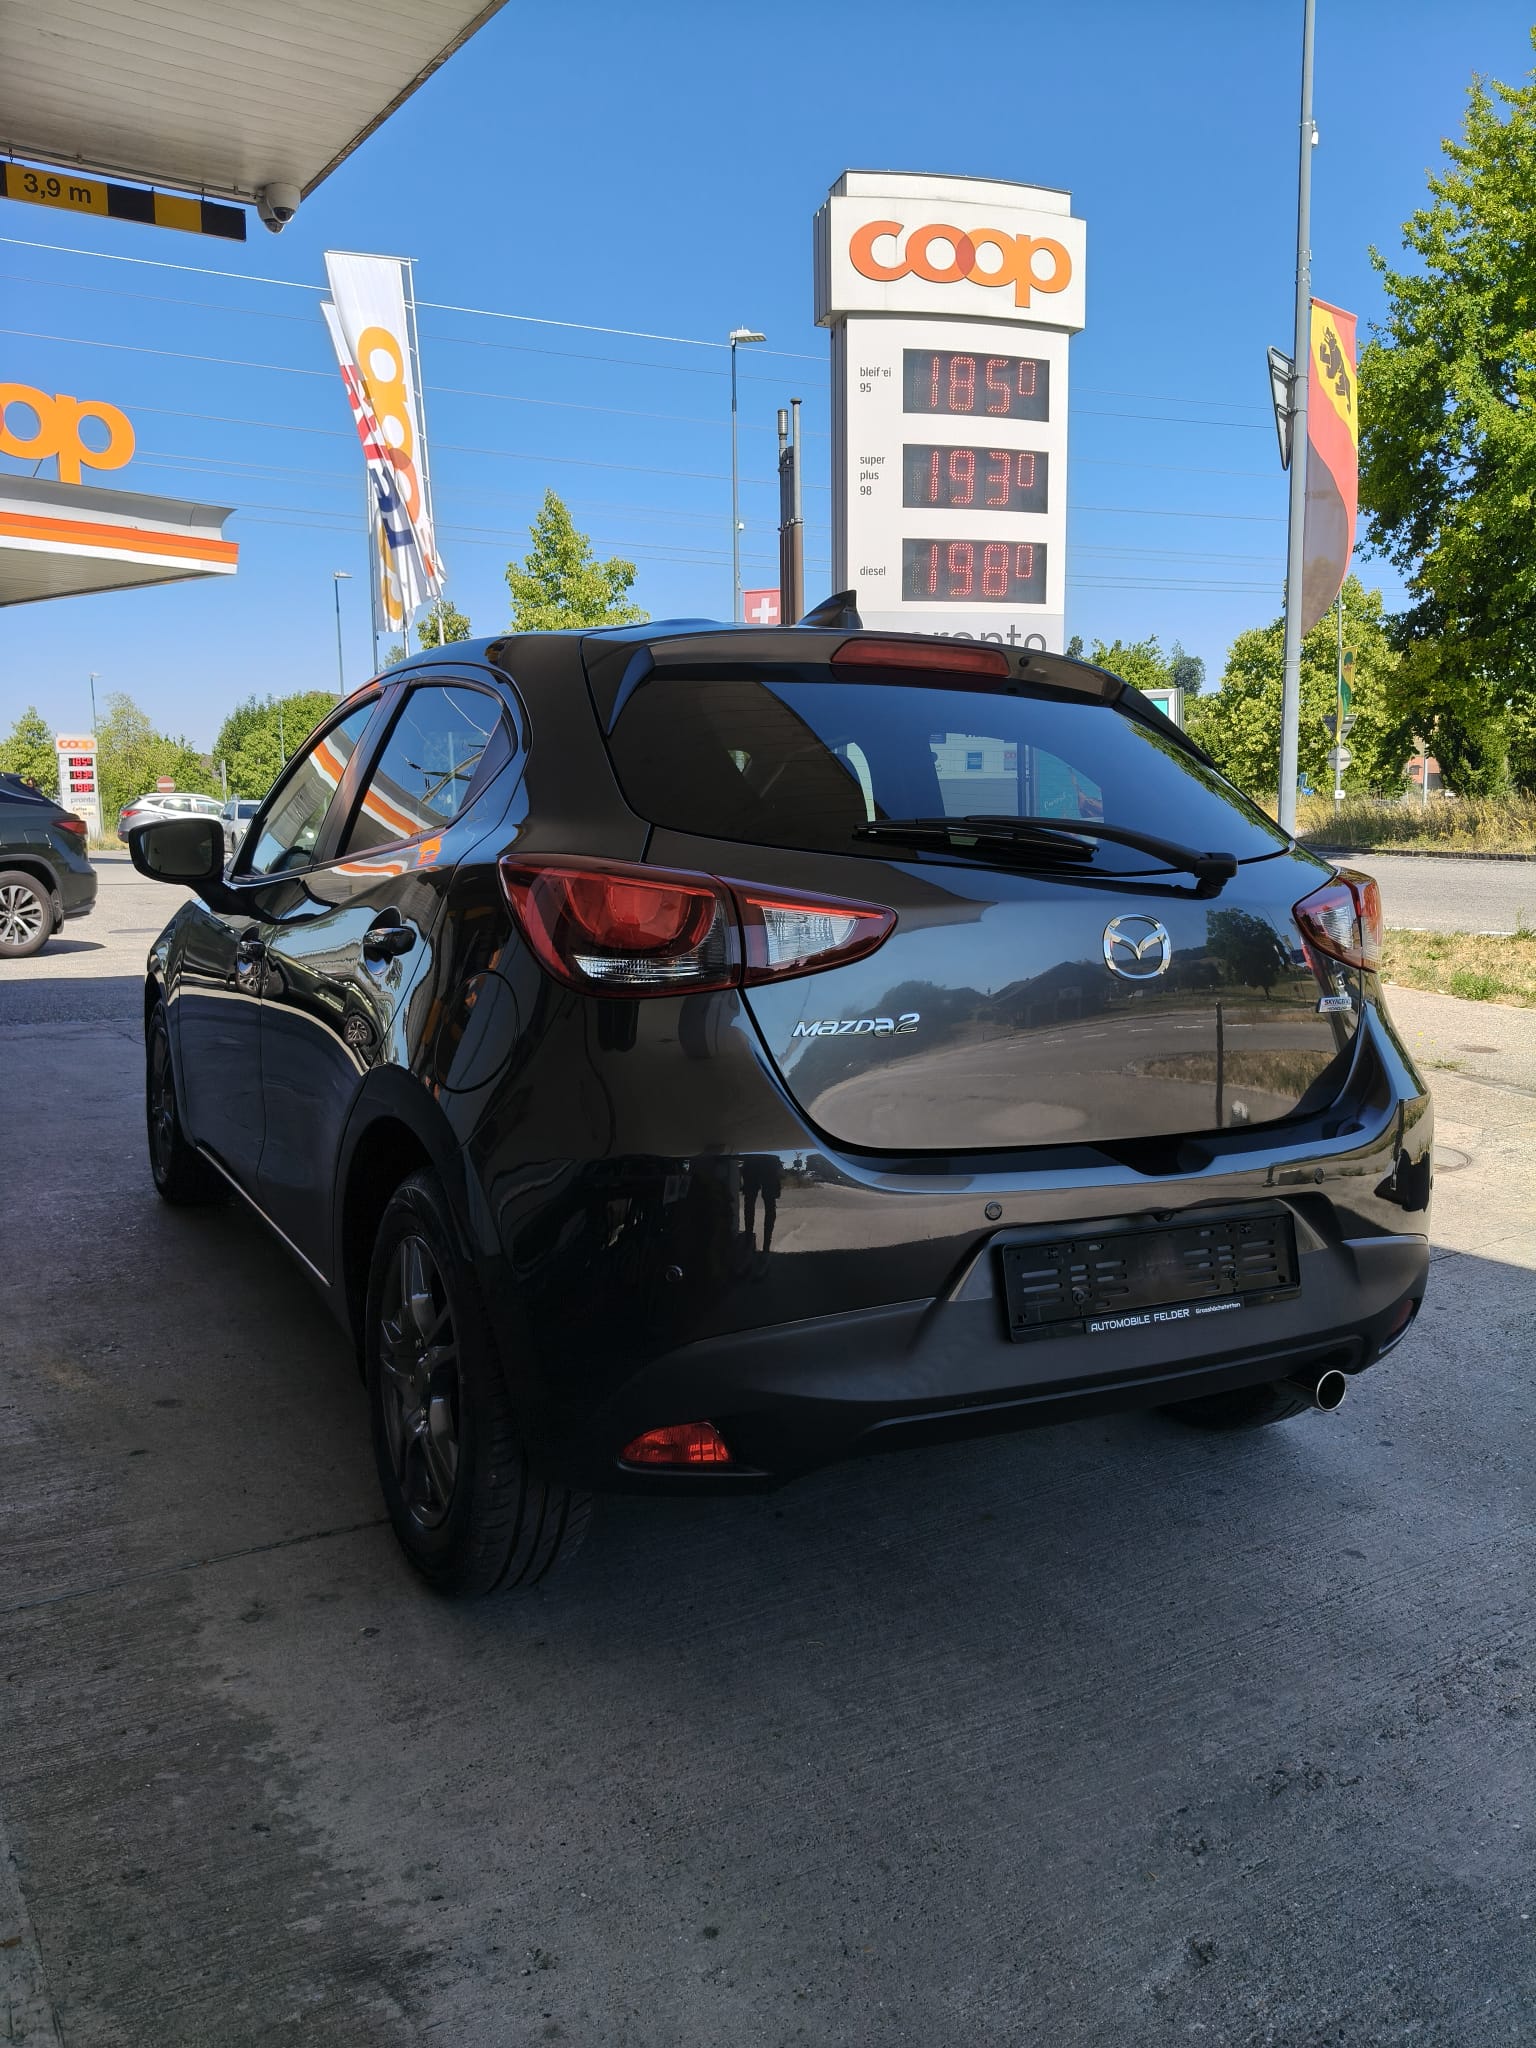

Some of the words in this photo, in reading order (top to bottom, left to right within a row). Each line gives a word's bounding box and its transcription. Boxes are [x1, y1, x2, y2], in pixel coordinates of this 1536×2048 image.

[23, 173, 61, 199] 3,9
[69, 185, 92, 204] m
[849, 220, 1072, 308] coop
[859, 383, 872, 393] 95
[0, 382, 136, 485] op
[859, 456, 886, 467] super
[859, 470, 880, 481] plus
[859, 486, 872, 496] 98
[859, 566, 886, 576] diesel
[58, 739, 95, 750] coop
[1090, 1314, 1151, 1333] AUTOMOBILE
[1153, 1308, 1190, 1323] FELDER
